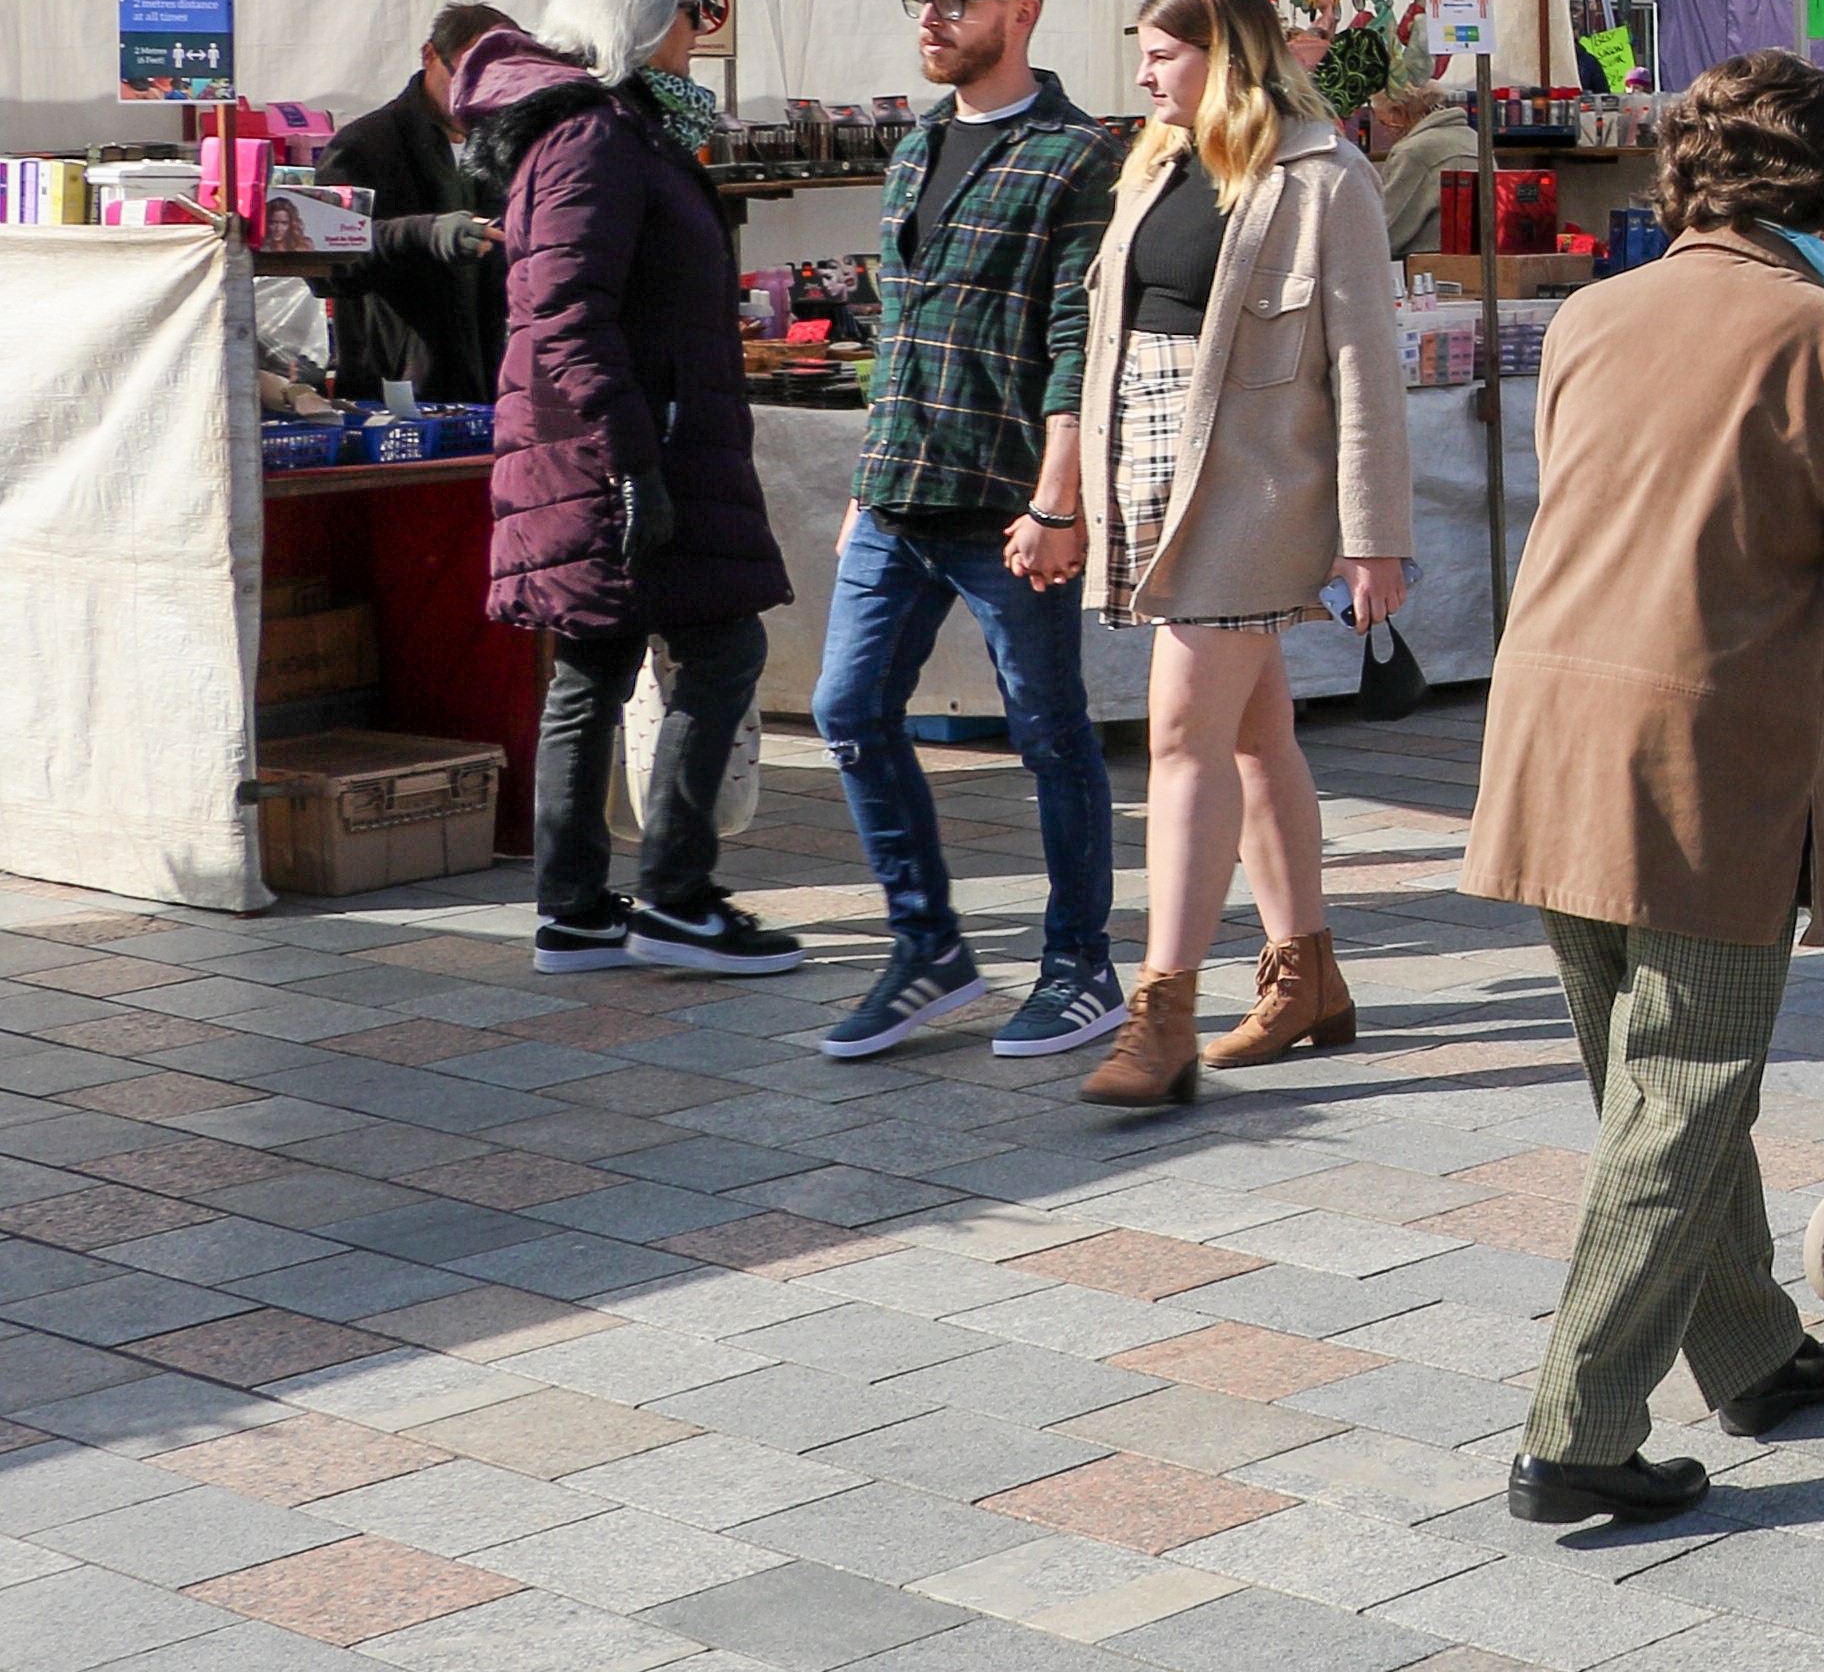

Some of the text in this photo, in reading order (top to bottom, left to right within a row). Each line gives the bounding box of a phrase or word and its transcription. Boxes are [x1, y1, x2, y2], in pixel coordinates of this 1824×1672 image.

[133, 0, 220, 10] 2 metres distance
[133, 11, 188, 22] at all times
